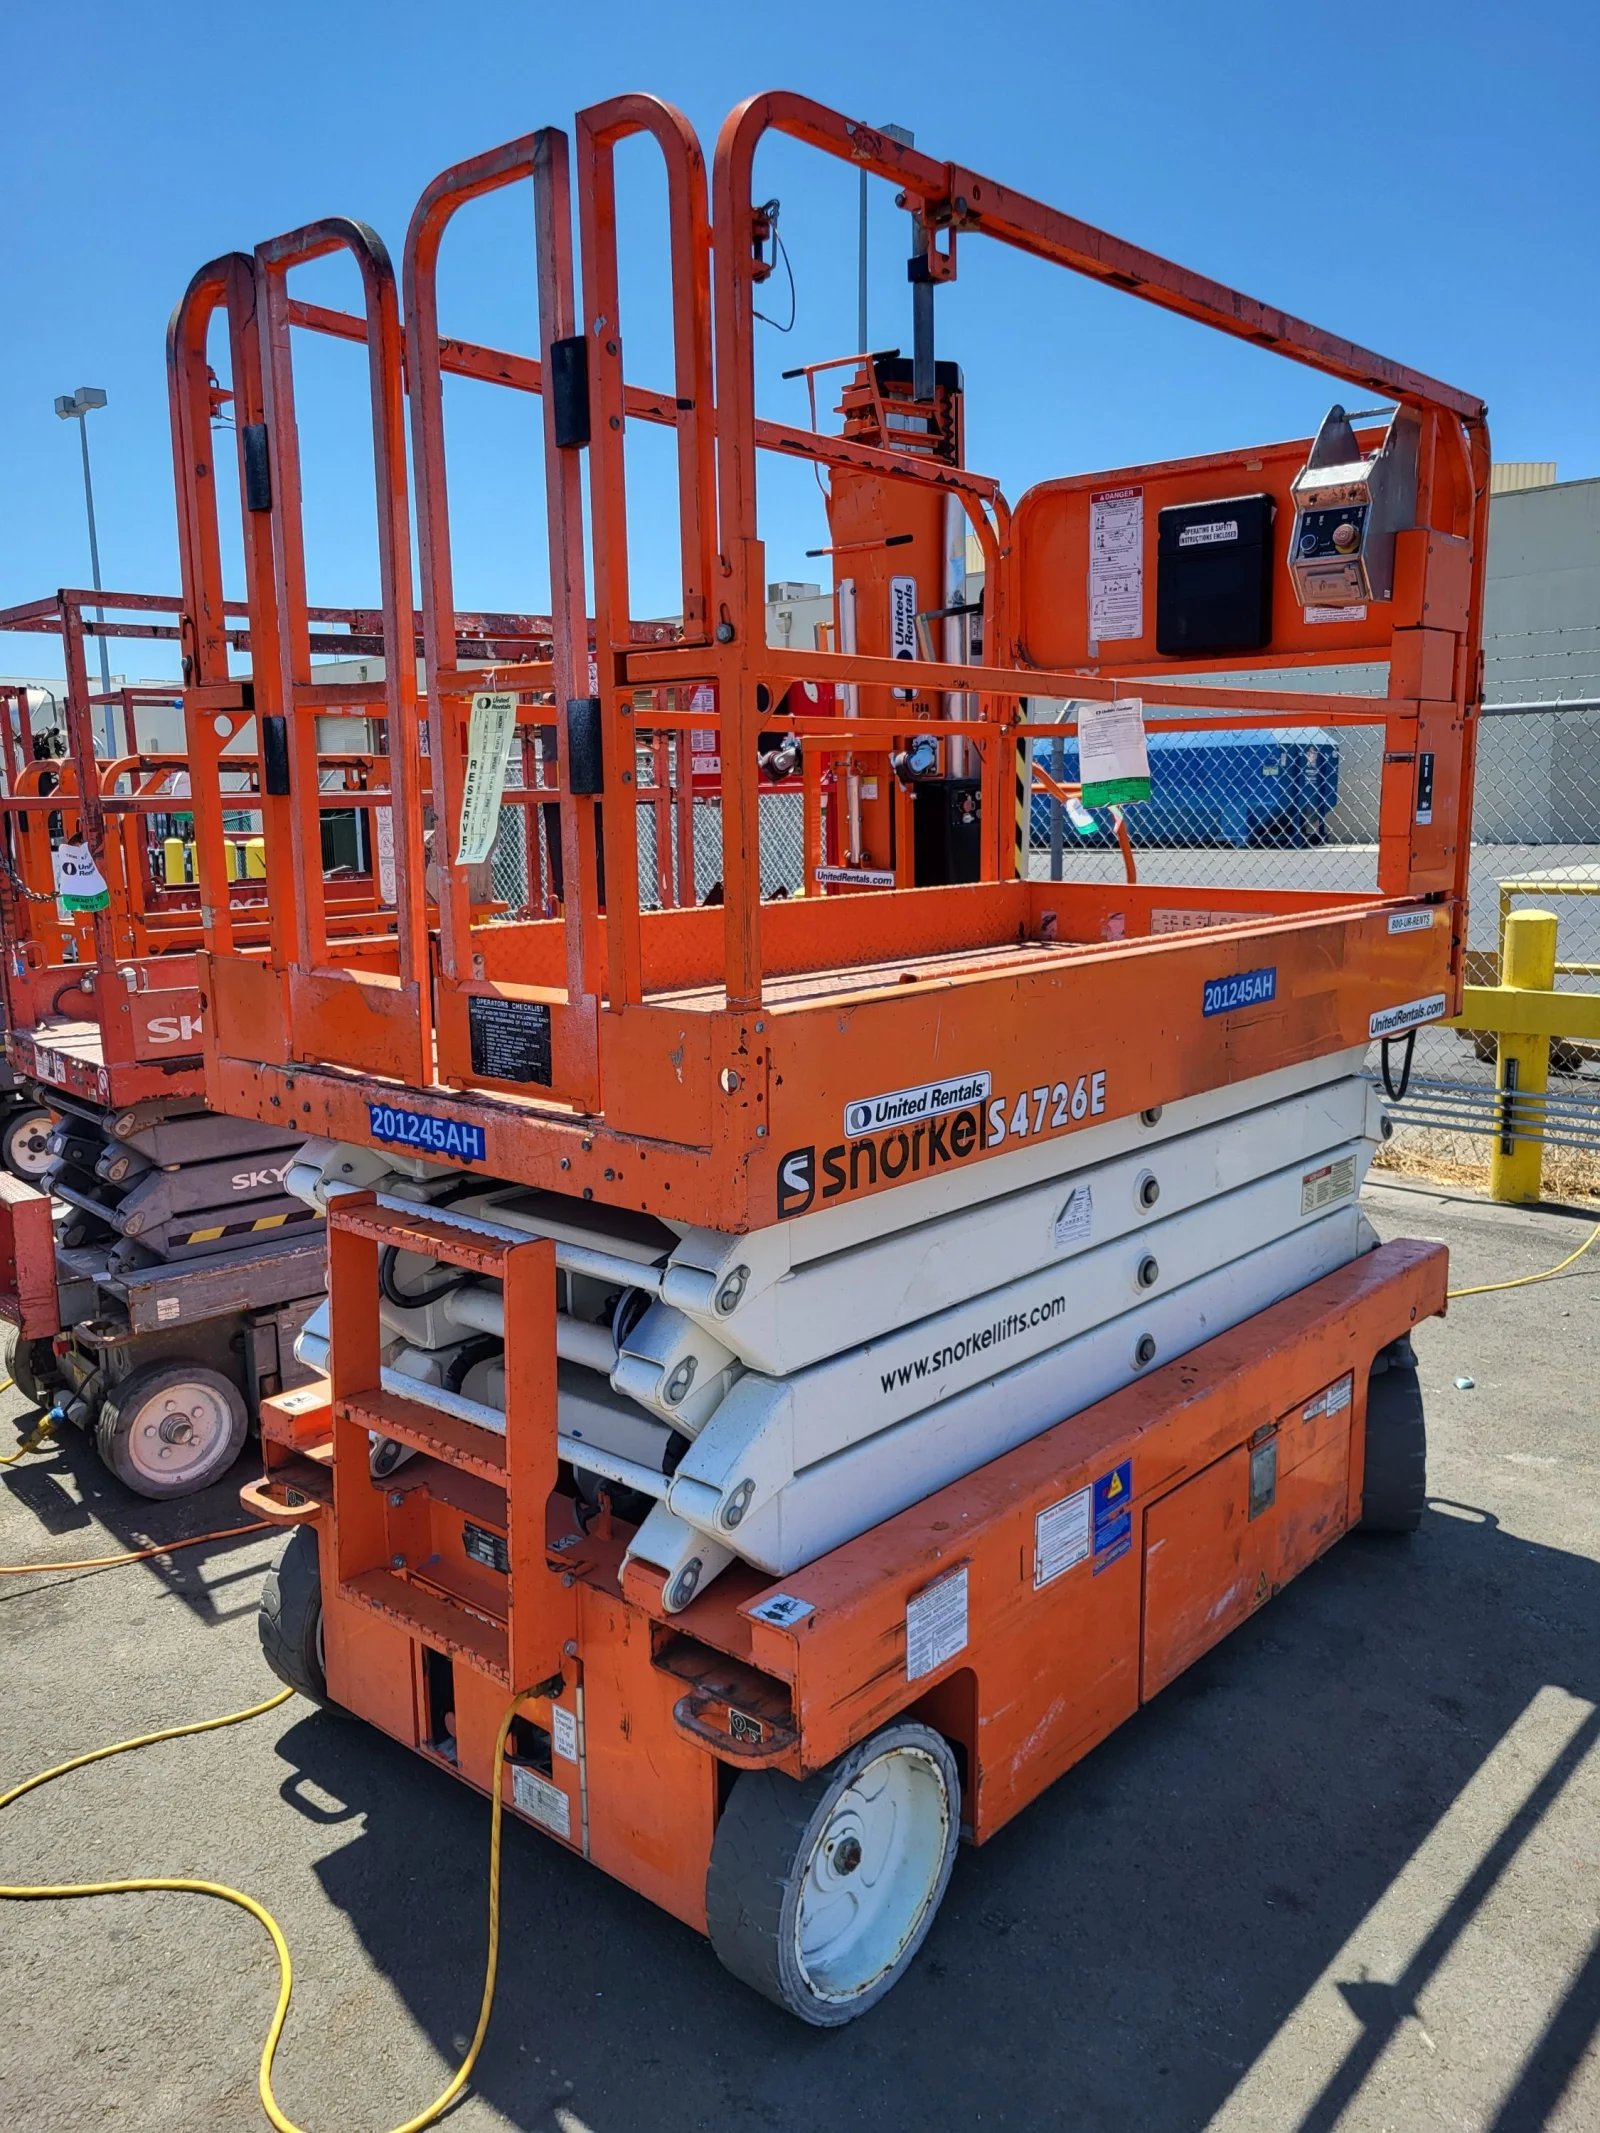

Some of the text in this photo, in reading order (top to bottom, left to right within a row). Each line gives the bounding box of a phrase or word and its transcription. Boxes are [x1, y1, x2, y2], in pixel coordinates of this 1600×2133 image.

[1105, 490, 1134, 500] DANGER
[1180, 530, 1237, 544] INSTRUCTIONS ENCLOSED
[1184, 526, 1210, 536] OPERATING
[1215, 523, 1233, 532] SAFETY
[894, 587, 904, 646] United
[904, 584, 914, 647] Rentals
[493, 696, 511, 704] United
[459, 759, 478, 858] RESERVED
[817, 871, 893, 885] UnitedRentals.com
[1391, 914, 1431, 930] 800-UR-RENTS
[476, 998, 544, 1013] OPERATORS CHECKLIST
[1204, 974, 1273, 1012] 201245AH
[1371, 1000, 1445, 1034] UnitedRentals.com
[875, 1078, 986, 1123] United Rentals
[371, 1107, 479, 1156] 201245AH
[821, 1100, 986, 1198] snorkel
[987, 1070, 1106, 1148] S4726E
[880, 1295, 1066, 1394] www.snorkellifts.com
